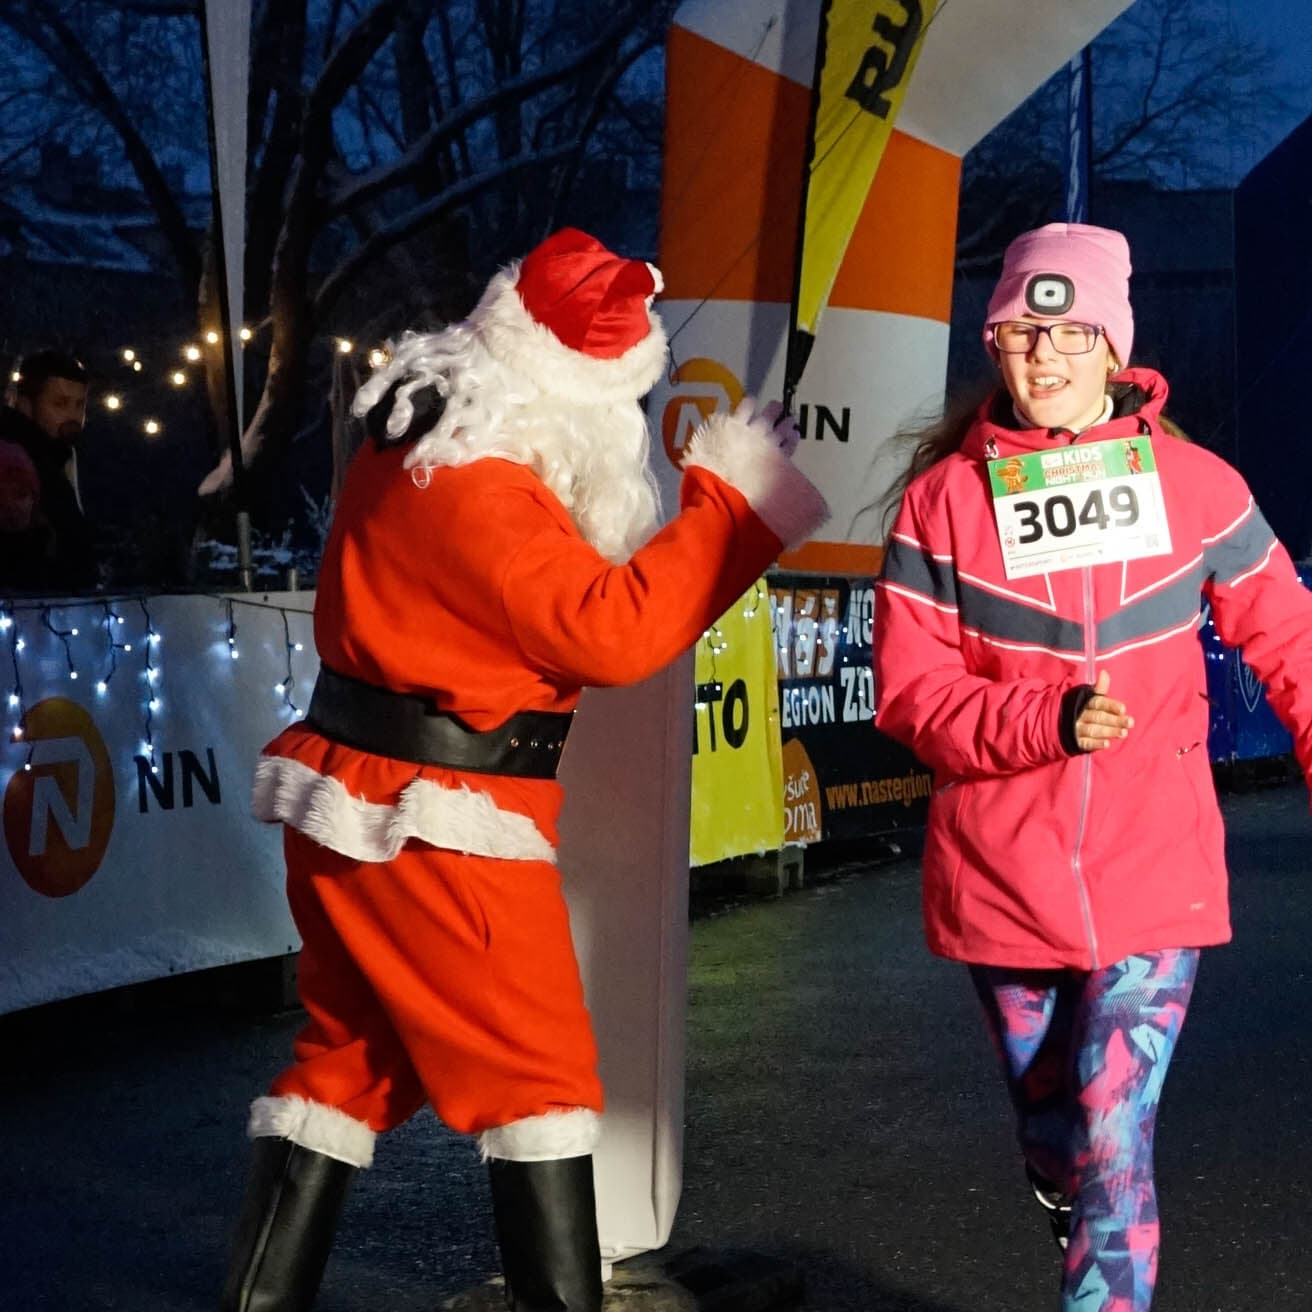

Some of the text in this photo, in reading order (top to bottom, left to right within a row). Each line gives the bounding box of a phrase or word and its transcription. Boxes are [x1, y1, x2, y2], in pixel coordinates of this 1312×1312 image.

[1063, 447, 1103, 465] KIDS
[1013, 484, 1140, 544] 3049
[782, 684, 836, 728] EGION
[133, 747, 222, 814] NN
